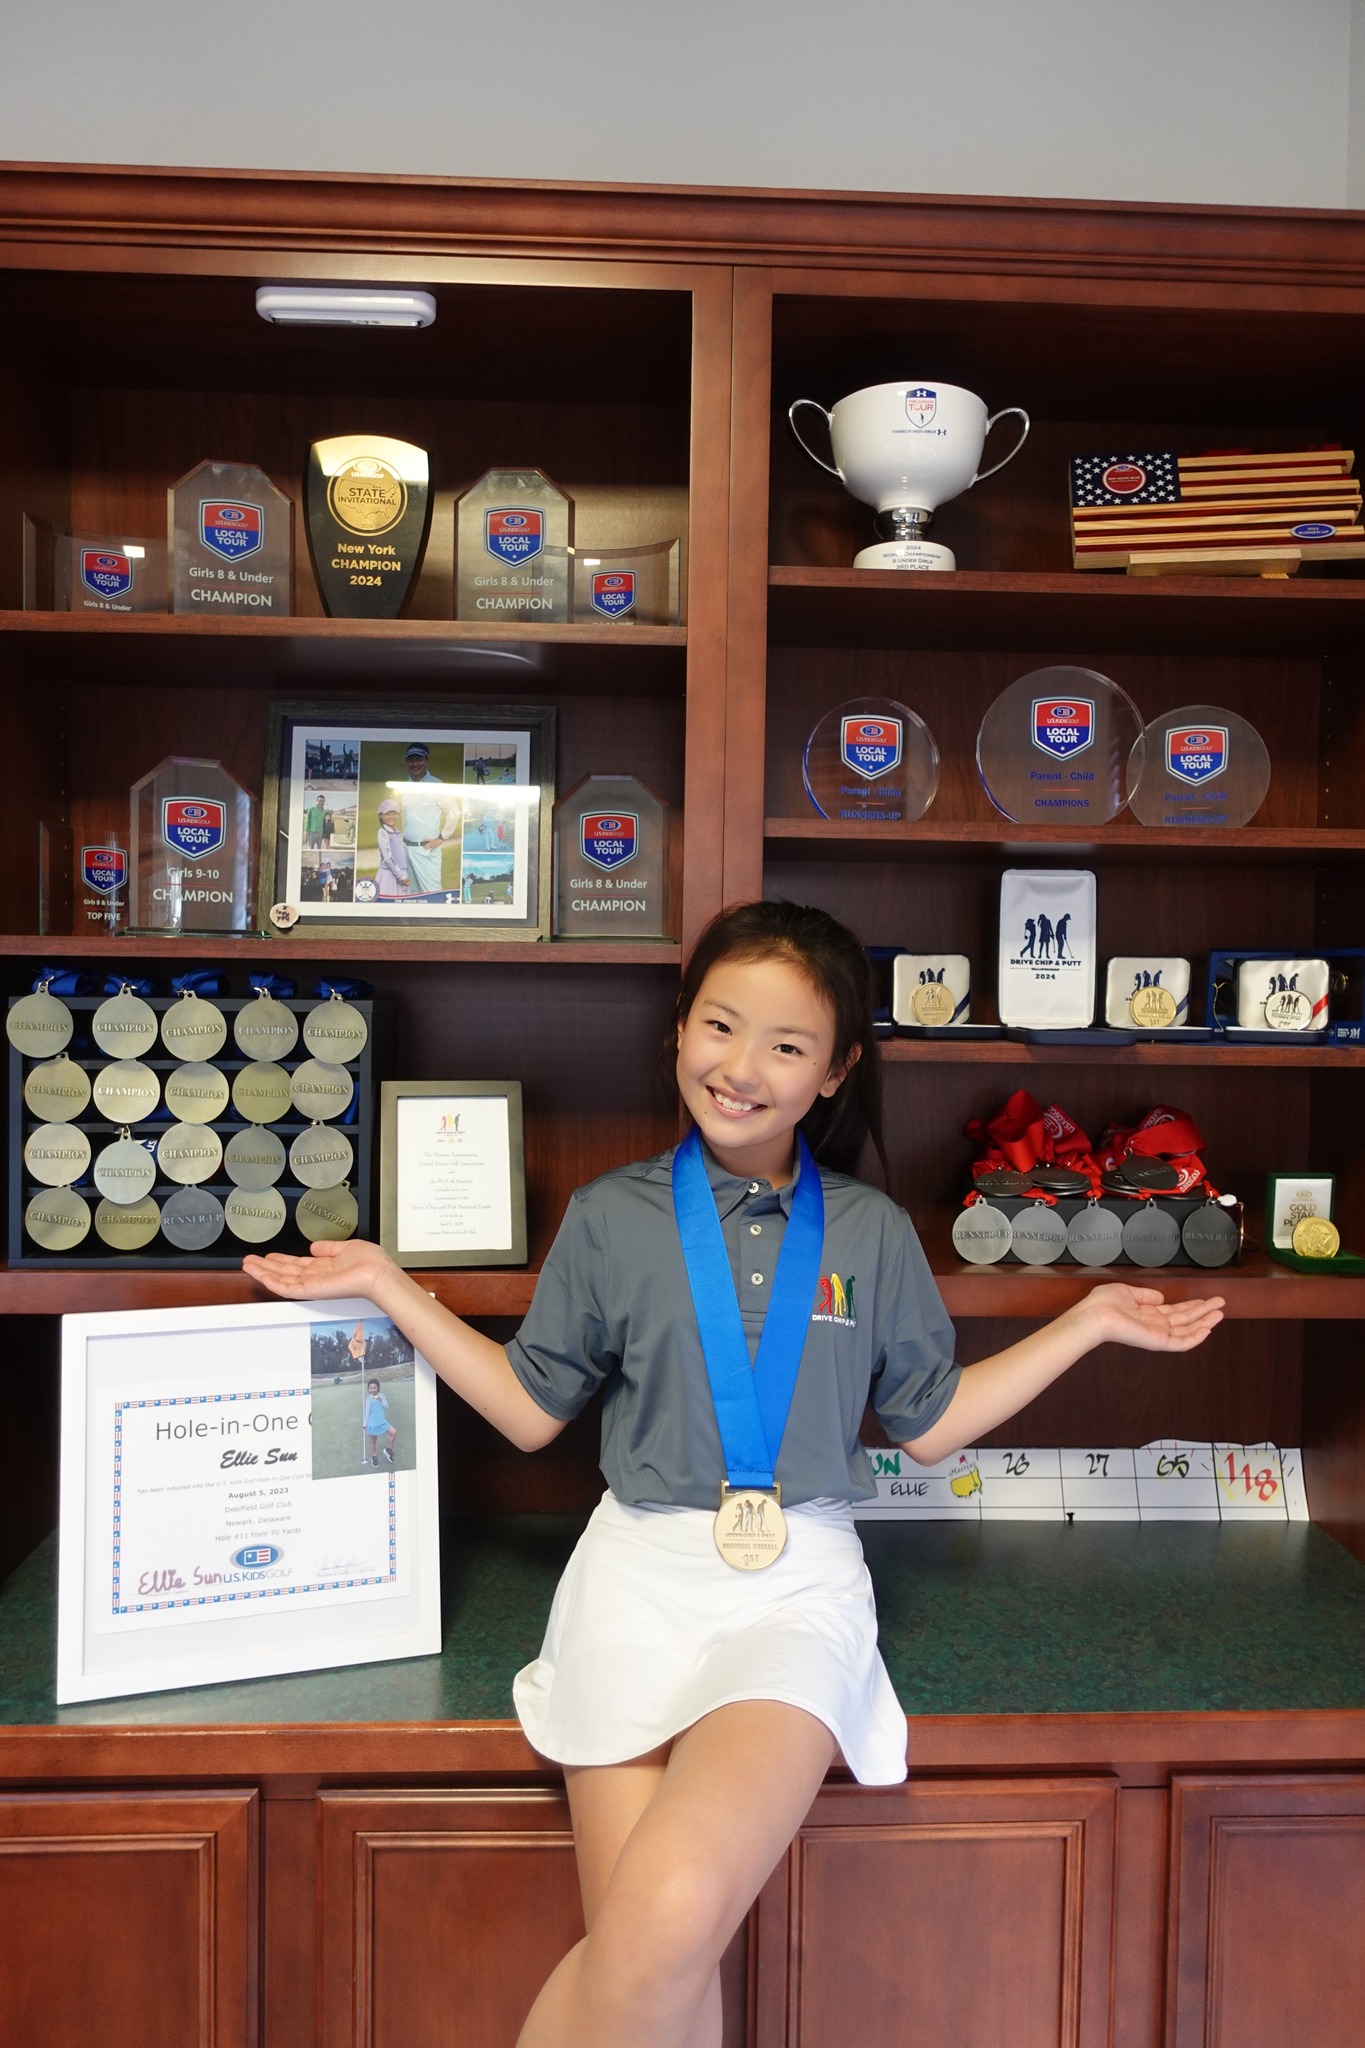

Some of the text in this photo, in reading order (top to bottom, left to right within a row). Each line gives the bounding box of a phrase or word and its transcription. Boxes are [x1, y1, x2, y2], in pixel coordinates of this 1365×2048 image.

[349, 487, 386, 499] STATE
[338, 496, 397, 506] INVITATIONAL
[215, 529, 249, 539] LOCAL
[217, 537, 247, 547] TOUR
[498, 536, 531, 545] LOCAL
[337, 543, 396, 556] New York
[500, 543, 529, 552] TOUR
[331, 558, 401, 571] CHAMPION
[93, 572, 121, 582] LOCAL
[189, 567, 274, 584] Girls 8 & Under
[350, 575, 382, 587] 2024
[95, 579, 120, 588] TOUR
[474, 576, 554, 587] Girls 8 & Under
[190, 589, 272, 607] CHAMPION
[83, 600, 98, 608] Girls
[111, 603, 132, 611] Under
[476, 598, 553, 610] CHAMPION
[1046, 727, 1080, 736] LOCAL
[1048, 735, 1078, 744] TOUR
[855, 746, 887, 755] LOCAL
[857, 753, 885, 763] TOUR
[1180, 754, 1213, 763] LOCAL
[1182, 761, 1211, 770] TOUR
[1030, 771, 1095, 781] Parent Child
[1034, 799, 1090, 808] CHAMPIONS
[177, 827, 211, 837] LOCAL
[179, 834, 209, 844] TOUR
[593, 840, 625, 848] LOCAL
[595, 847, 623, 855] TOUR
[91, 869, 116, 877] LOCAL
[167, 867, 220, 880] Girls 9-10
[570, 879, 648, 889] Girls 8 & Under
[152, 888, 234, 904] CHAMPION
[571, 899, 646, 912] CHAMPION
[87, 912, 121, 921] TOP FIVE
[10, 1019, 69, 1033] CHAMPION
[96, 1022, 154, 1033] CHAMPION
[165, 1023, 223, 1037] CHAMPION
[237, 1025, 295, 1035] CHAMPION
[306, 1027, 364, 1039] CHAMPION
[27, 1083, 87, 1098] CHAMPION
[97, 1085, 157, 1098] CHAMPION
[168, 1086, 225, 1100] CHAMPION
[235, 1087, 290, 1099] CHAMPION
[293, 1083, 349, 1095] CHAMPION
[28, 1149, 87, 1160] CHAMPION
[160, 1148, 219, 1160] CHAMPION
[226, 1154, 282, 1165] CHAMPION
[292, 1151, 349, 1166] CHAMPION
[97, 1167, 152, 1178] CHAMPION
[228, 1205, 283, 1220] CHAMPION
[1289, 1203, 1317, 1212] GOLD
[29, 1210, 87, 1229] CHAMPION
[98, 1214, 157, 1225] CHAMPION
[162, 1214, 223, 1226] RUNNER-UP
[301, 1200, 354, 1231] CHAMPION
[1290, 1211, 1315, 1220] STAR
[954, 1230, 1011, 1240] RUNNER-UP
[811, 1314, 833, 1322] DRIVE
[156, 1414, 299, 1441] Hole-in-One
[220, 1448, 298, 1469] Ellie Sun
[870, 1451, 1278, 1502] UN 26 27 65 118
[228, 1487, 289, 1499] August 5, 2023
[890, 1481, 930, 1497] ELLIE
[224, 1500, 293, 1514] Deerfield Golf Club
[225, 1515, 292, 1527] Newark, Delaware
[215, 1534, 232, 1542] Hole
[234, 1532, 248, 1540] #11
[250, 1530, 269, 1538] from
[281, 1527, 302, 1535] Yards
[742, 1553, 759, 1566] 1ST
[138, 1565, 223, 1596] Ellie Sun
